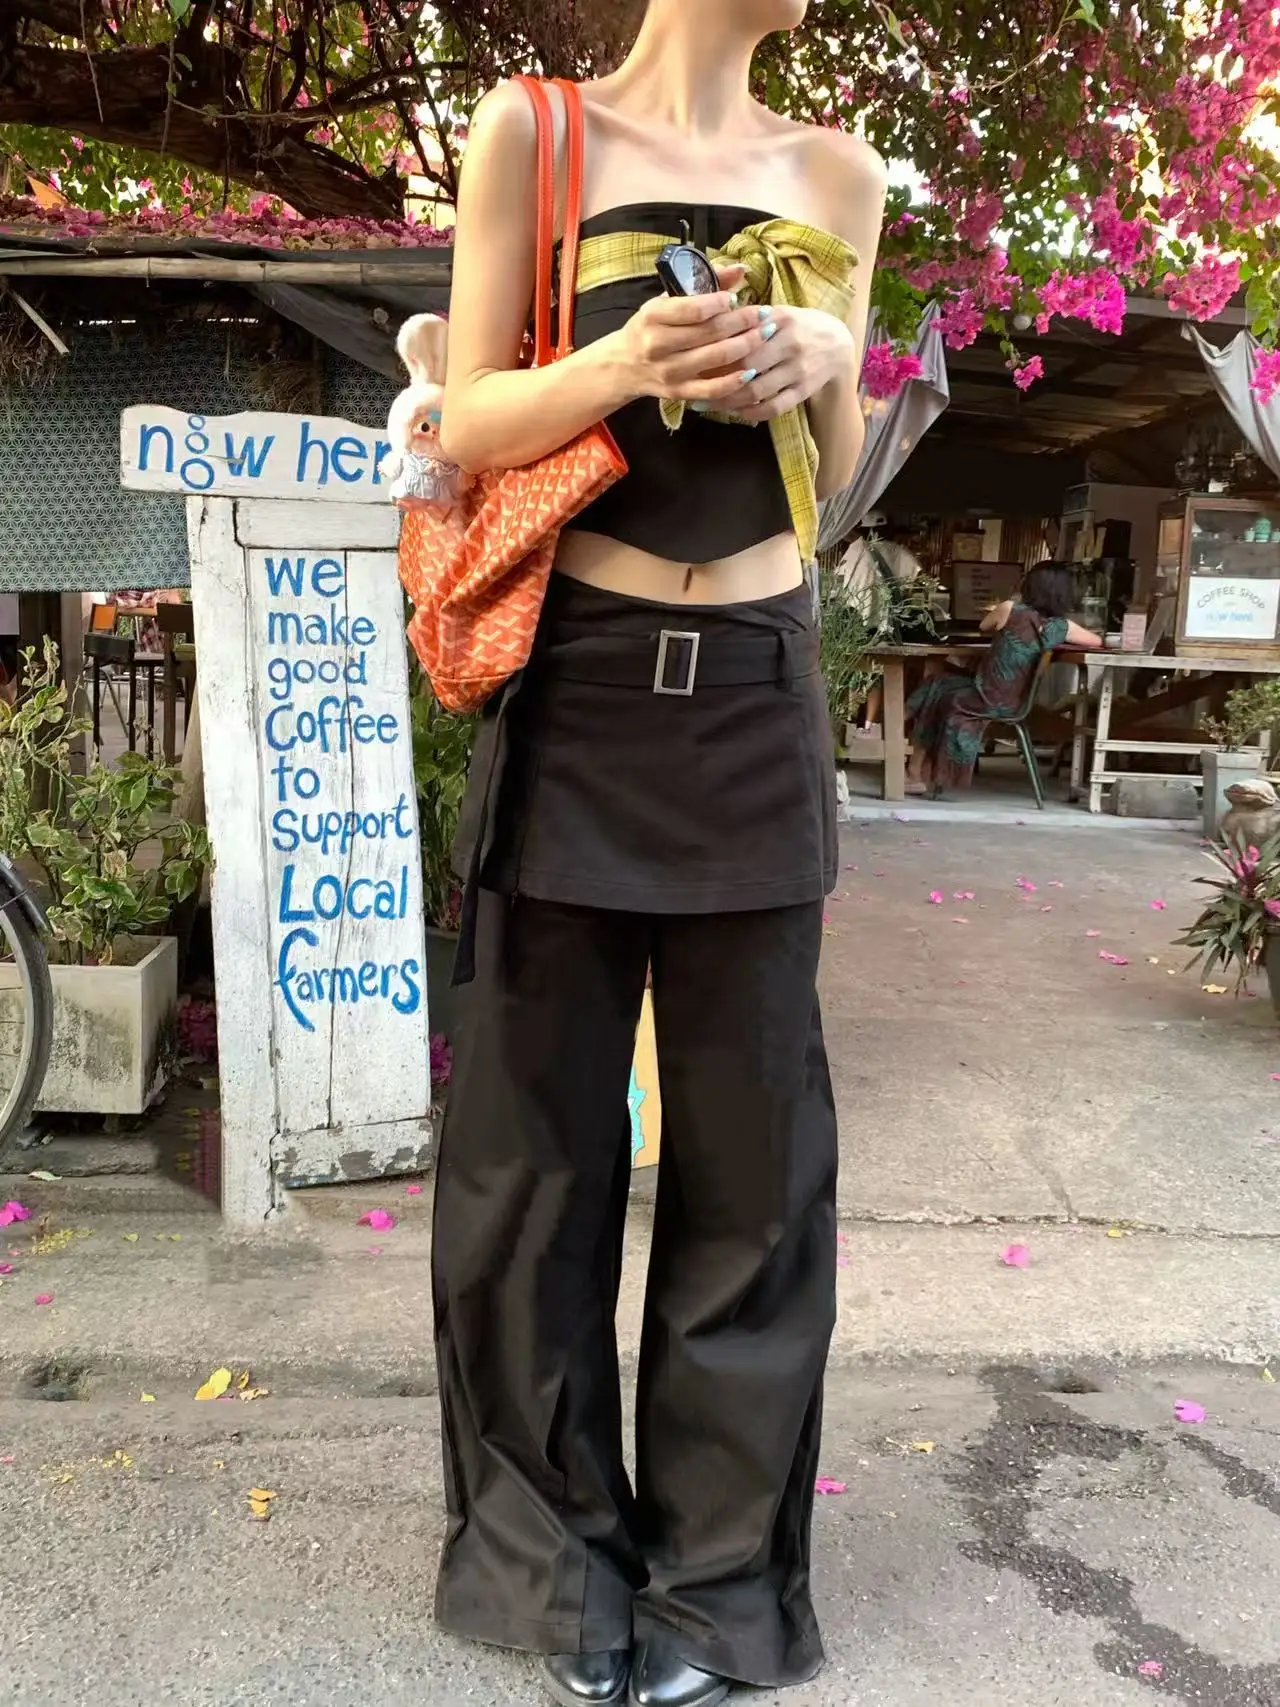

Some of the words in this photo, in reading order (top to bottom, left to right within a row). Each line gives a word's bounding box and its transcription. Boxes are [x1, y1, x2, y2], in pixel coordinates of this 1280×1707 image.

[296, 421, 392, 485] her
[264, 557, 344, 598] we
[1197, 586, 1235, 608] COFFEE
[267, 603, 377, 646] make
[267, 651, 367, 700] good
[265, 695, 398, 752] Coffee
[271, 756, 321, 801] to
[279, 864, 408, 924] Local
[275, 927, 420, 1032] farmers
